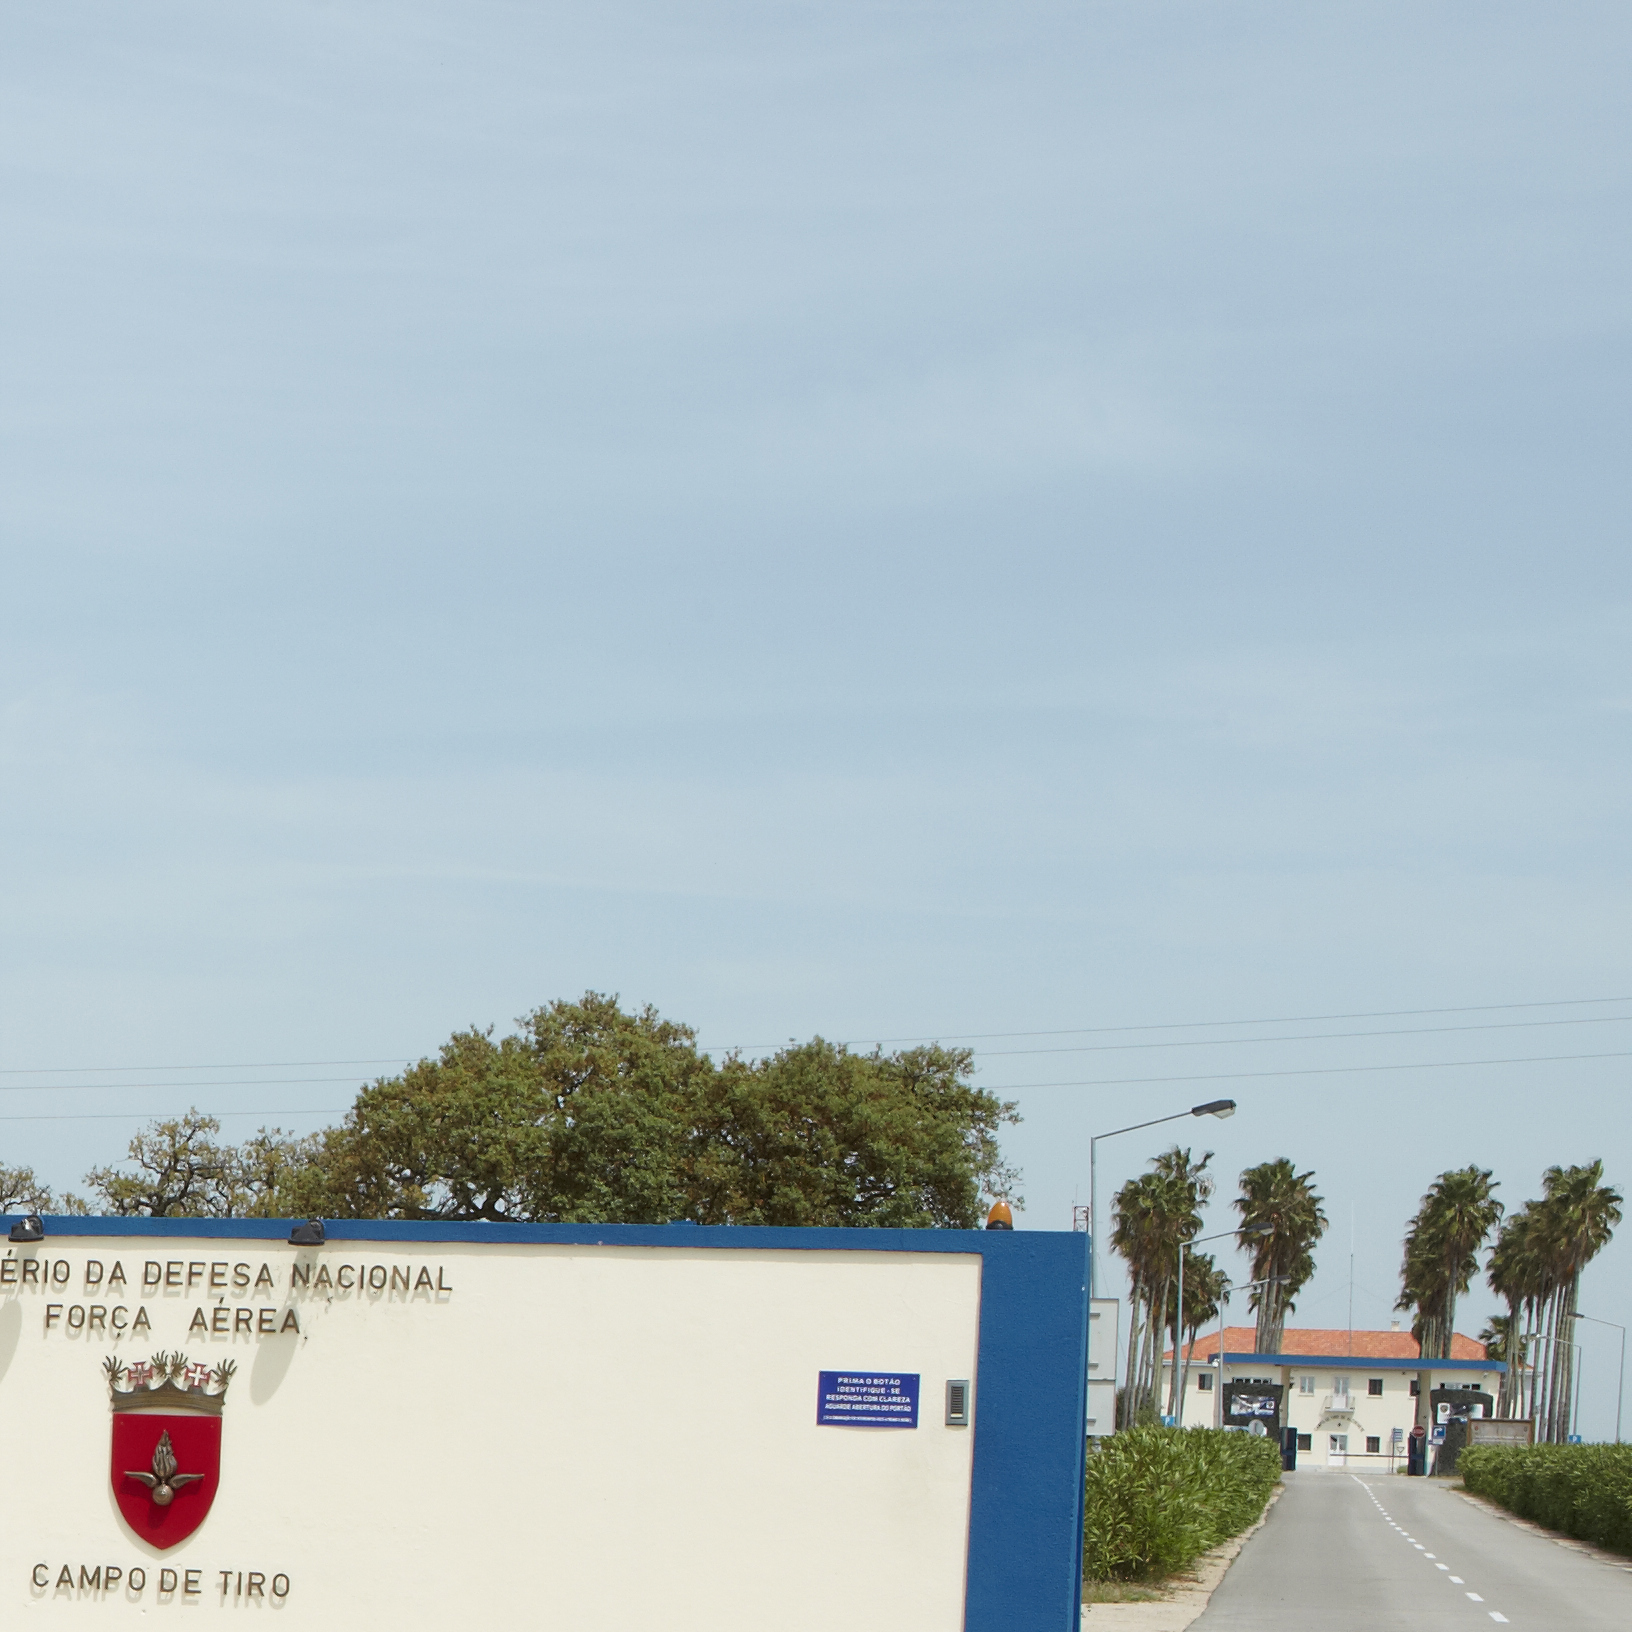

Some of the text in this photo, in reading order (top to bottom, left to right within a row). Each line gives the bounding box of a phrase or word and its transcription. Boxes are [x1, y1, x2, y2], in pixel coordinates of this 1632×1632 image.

[85, 1260, 127, 1285] DA
[143, 1261, 274, 1288] DEFESA
[291, 1263, 453, 1292] NACIONAL
[45, 1296, 300, 1339] FORÇA AÉREA
[837, 1377, 864, 1385] PRIMA
[865, 1377, 872, 1385] O
[825, 1394, 862, 1402] RESPONDA
[879, 1395, 911, 1403] CLAREZA
[32, 1563, 290, 1598] CAMPO DE TIRO
